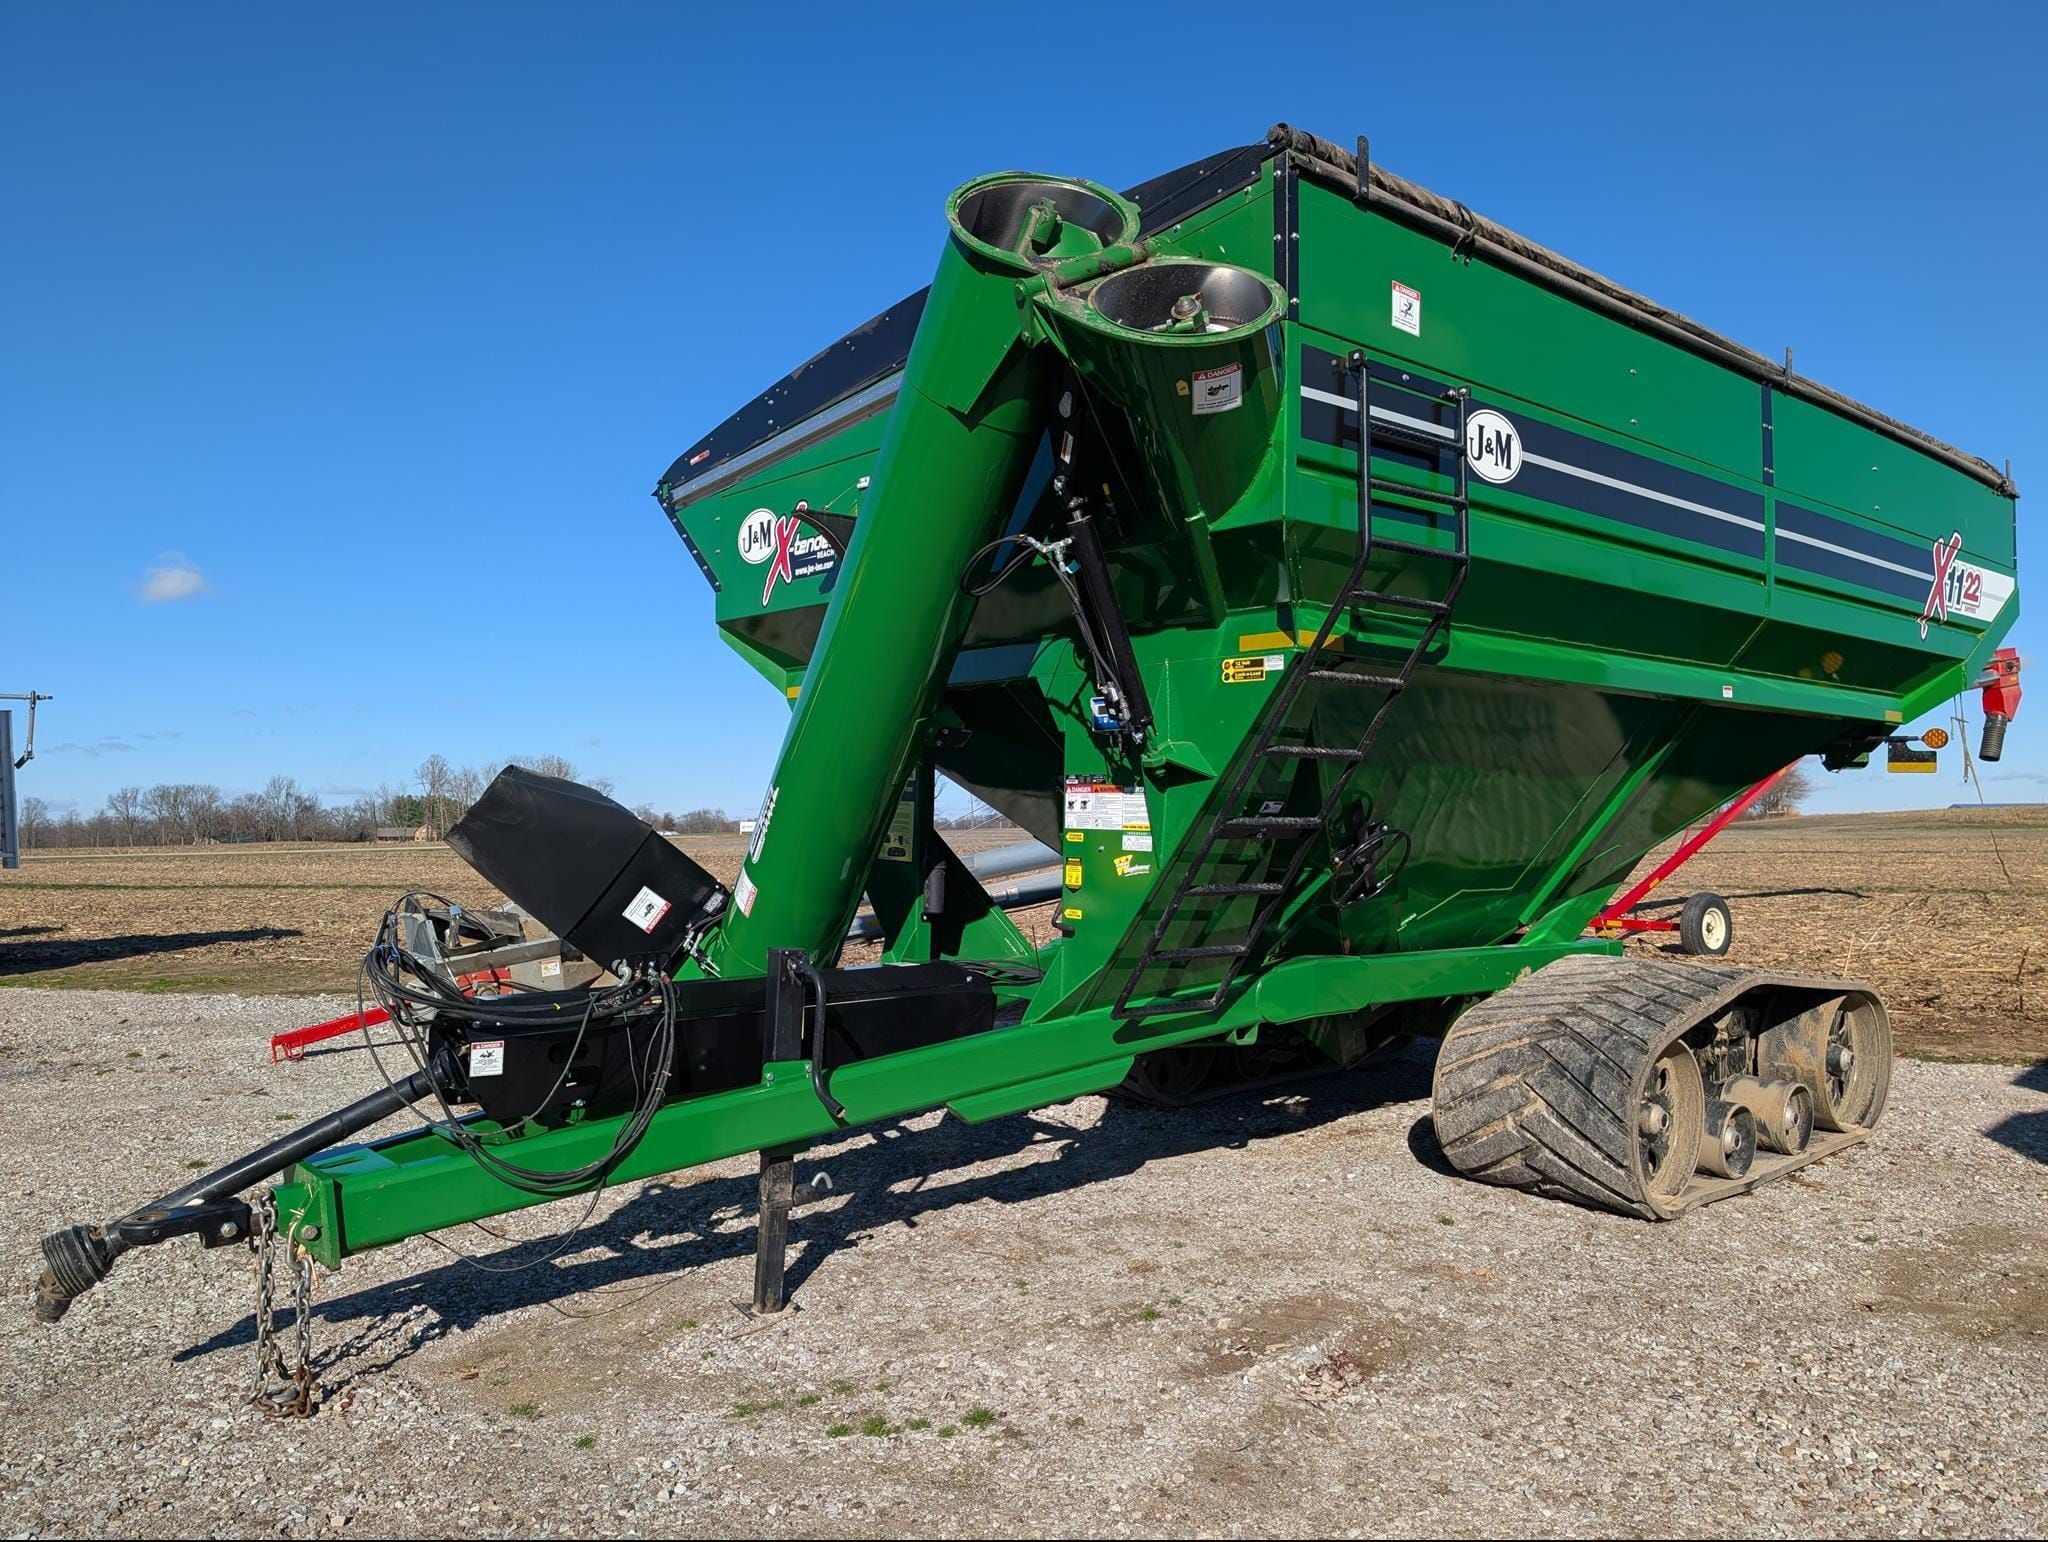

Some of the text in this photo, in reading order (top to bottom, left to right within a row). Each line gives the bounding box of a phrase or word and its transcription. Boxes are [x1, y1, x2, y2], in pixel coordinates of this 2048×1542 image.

[1399, 286, 1418, 299] DANGER
[1207, 363, 1238, 379] DANGER
[1469, 424, 1513, 470] J&M
[742, 519, 773, 553] J&M
